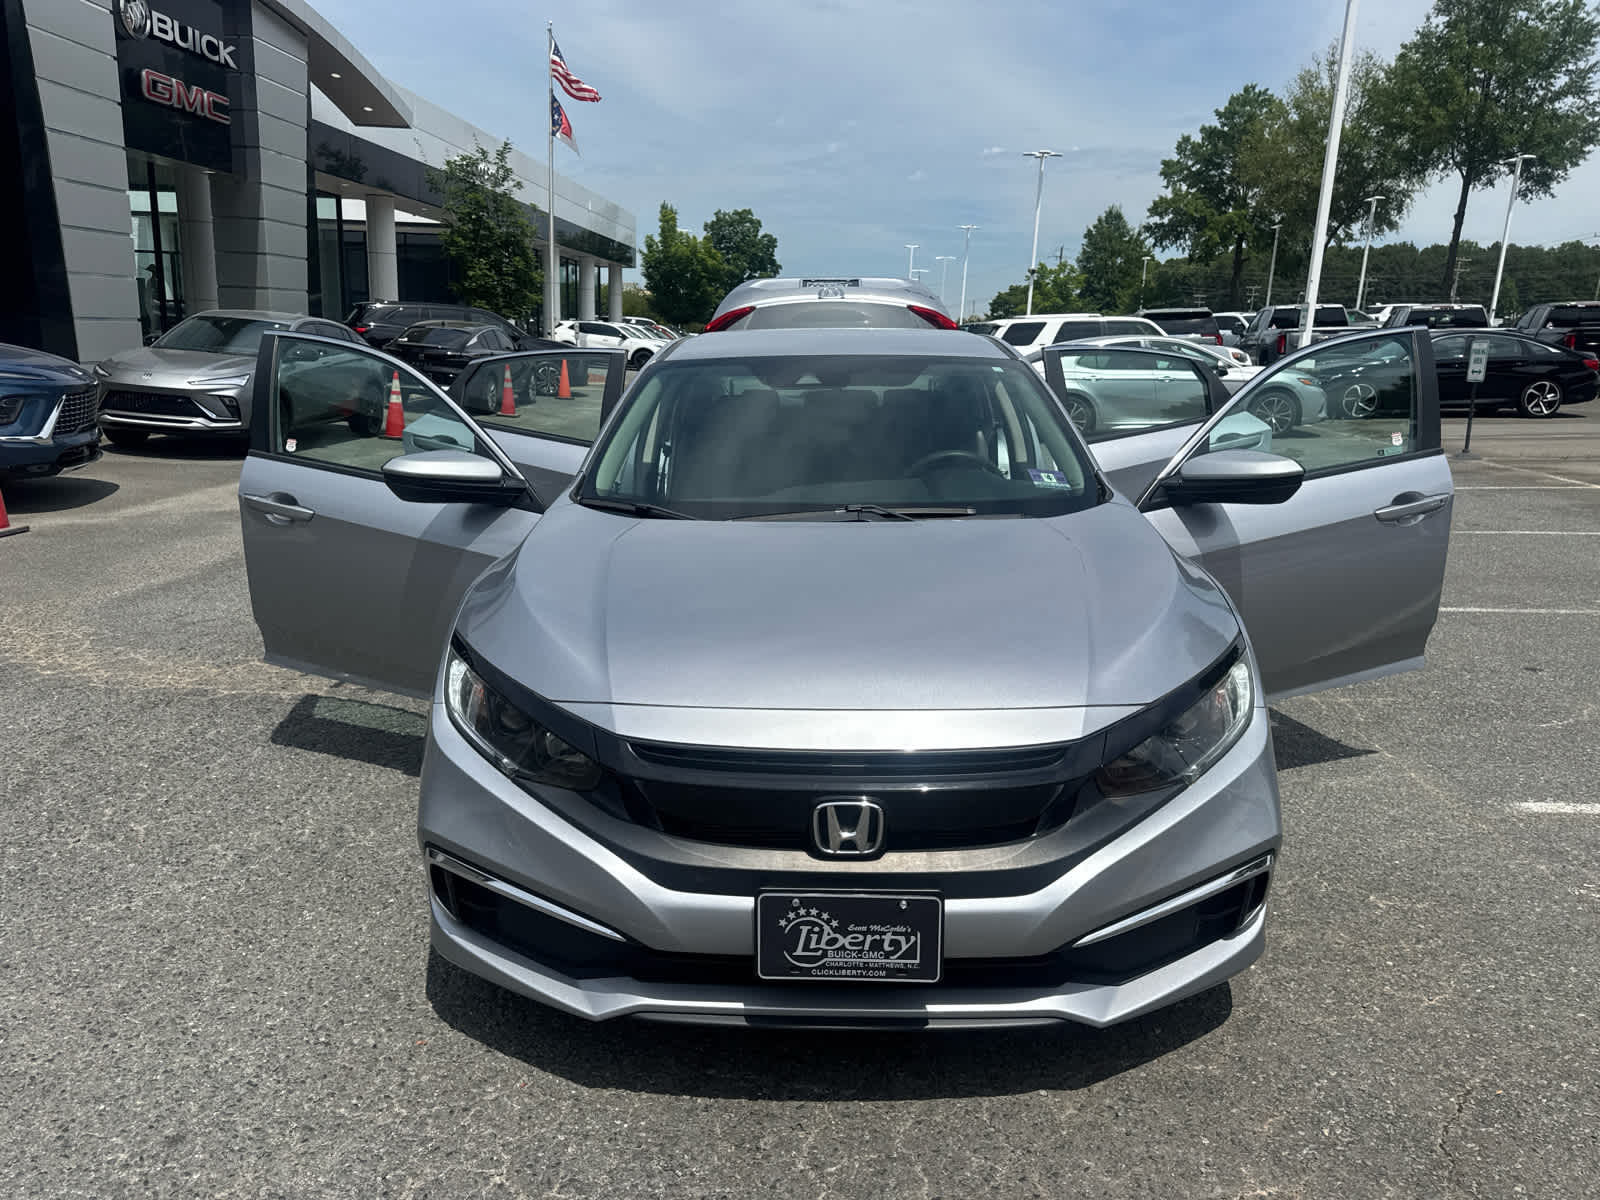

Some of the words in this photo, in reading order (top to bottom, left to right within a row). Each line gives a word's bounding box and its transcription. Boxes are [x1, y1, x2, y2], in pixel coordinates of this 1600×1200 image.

[151, 9, 238, 70] BUICK
[141, 68, 231, 125] GMC
[792, 924, 917, 960] Liberty
[827, 950, 885, 959] BUICK-GMC
[811, 969, 886, 977] CLICKLIBERTY.COM
